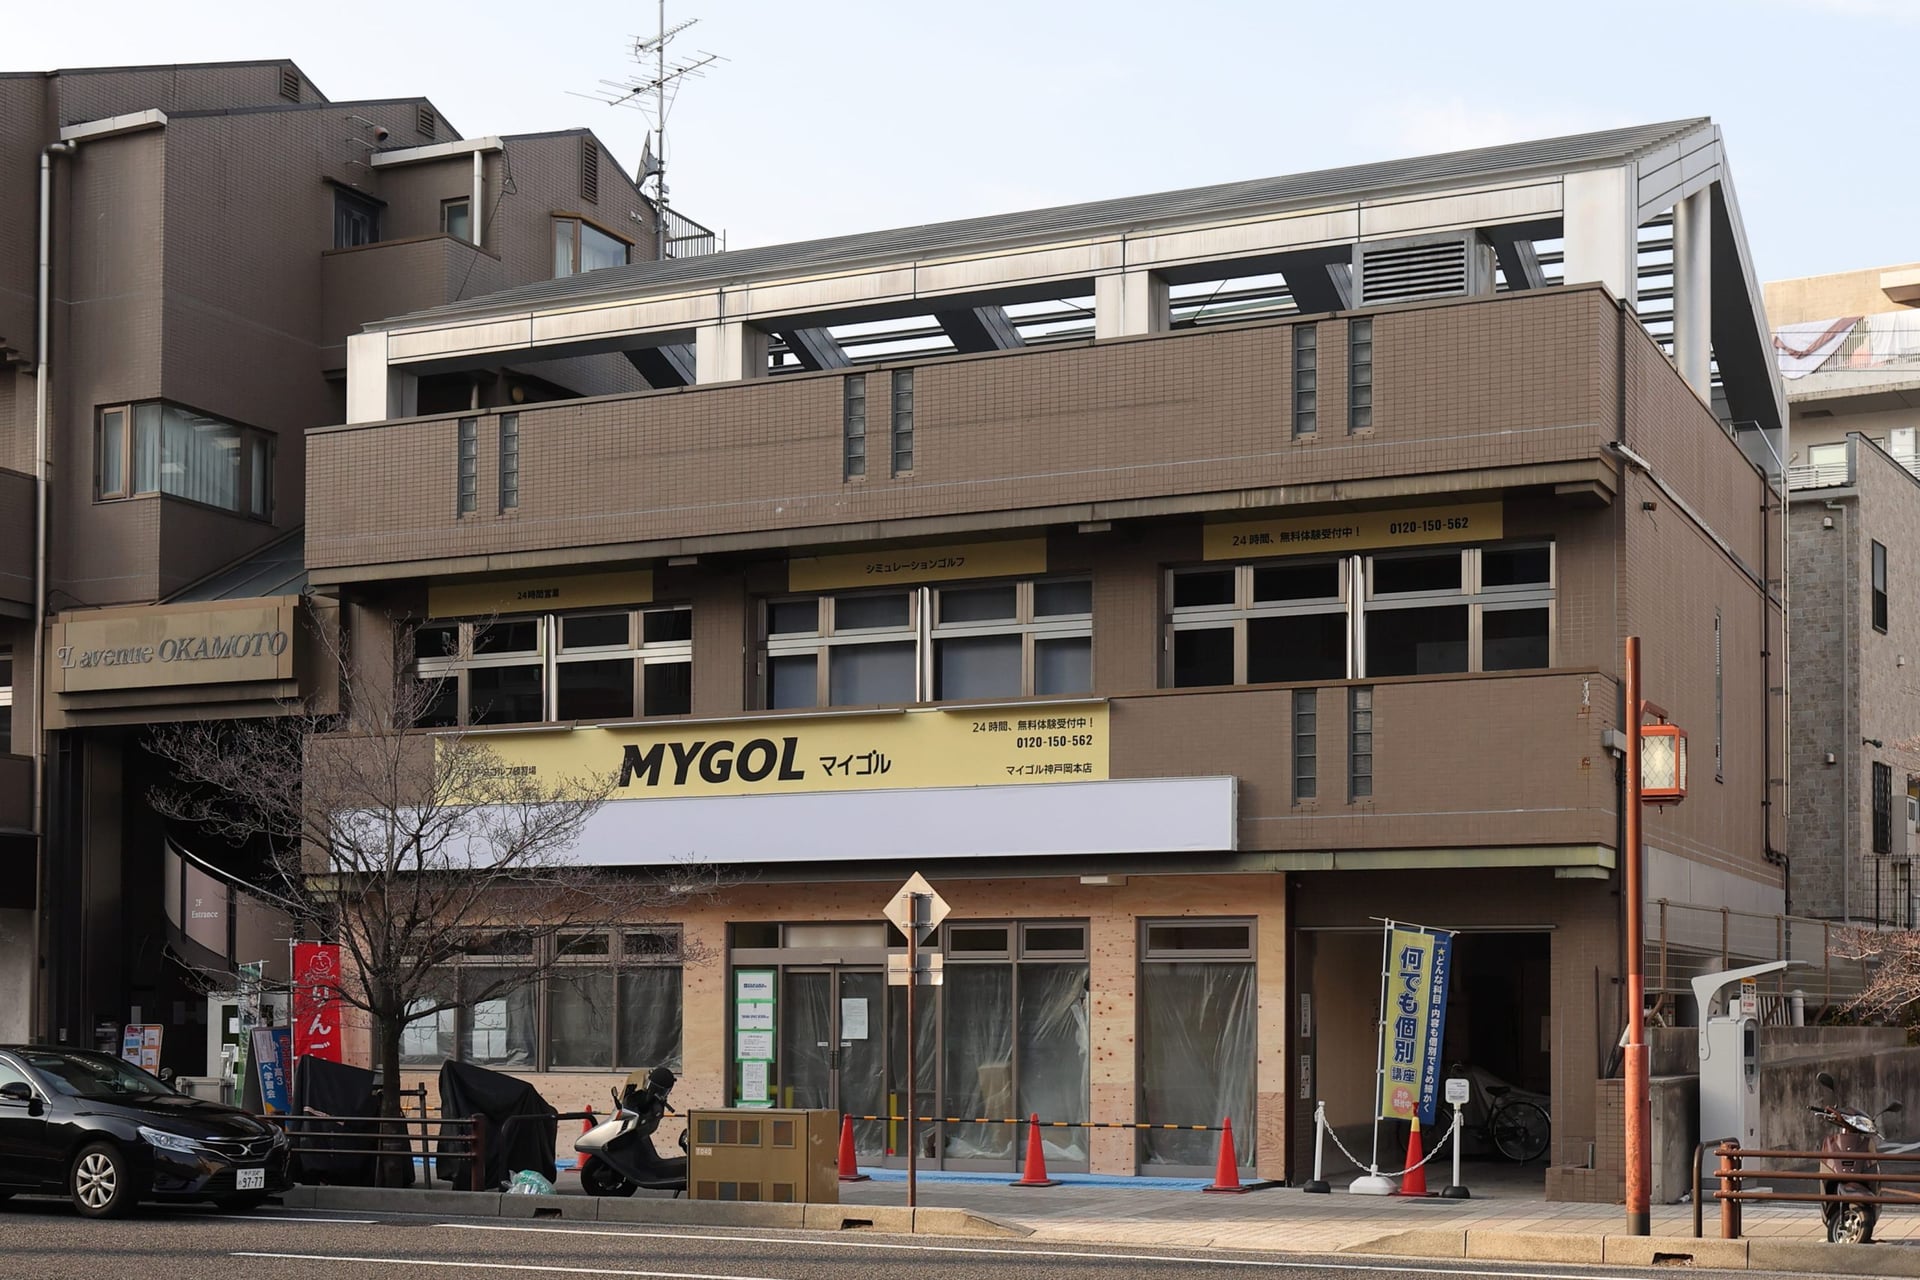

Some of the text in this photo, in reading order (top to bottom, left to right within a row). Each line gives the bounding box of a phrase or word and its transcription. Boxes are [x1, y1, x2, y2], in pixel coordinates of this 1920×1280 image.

[1390, 517, 1469, 534] 0120-150-562
[866, 557, 965, 574] シミュレーションゴルフ
[158, 631, 288, 662] OKAMOTO
[1017, 734, 1093, 749] 0120-150-562
[619, 736, 805, 788] MYGOL
[819, 749, 892, 777] マイゴル
[1006, 763, 1093, 776] マイゴル神戸岡本店
[191, 910, 219, 919] Entrance
[1393, 945, 1425, 1064] 何でも個別
[1391, 1066, 1417, 1083] 講座
